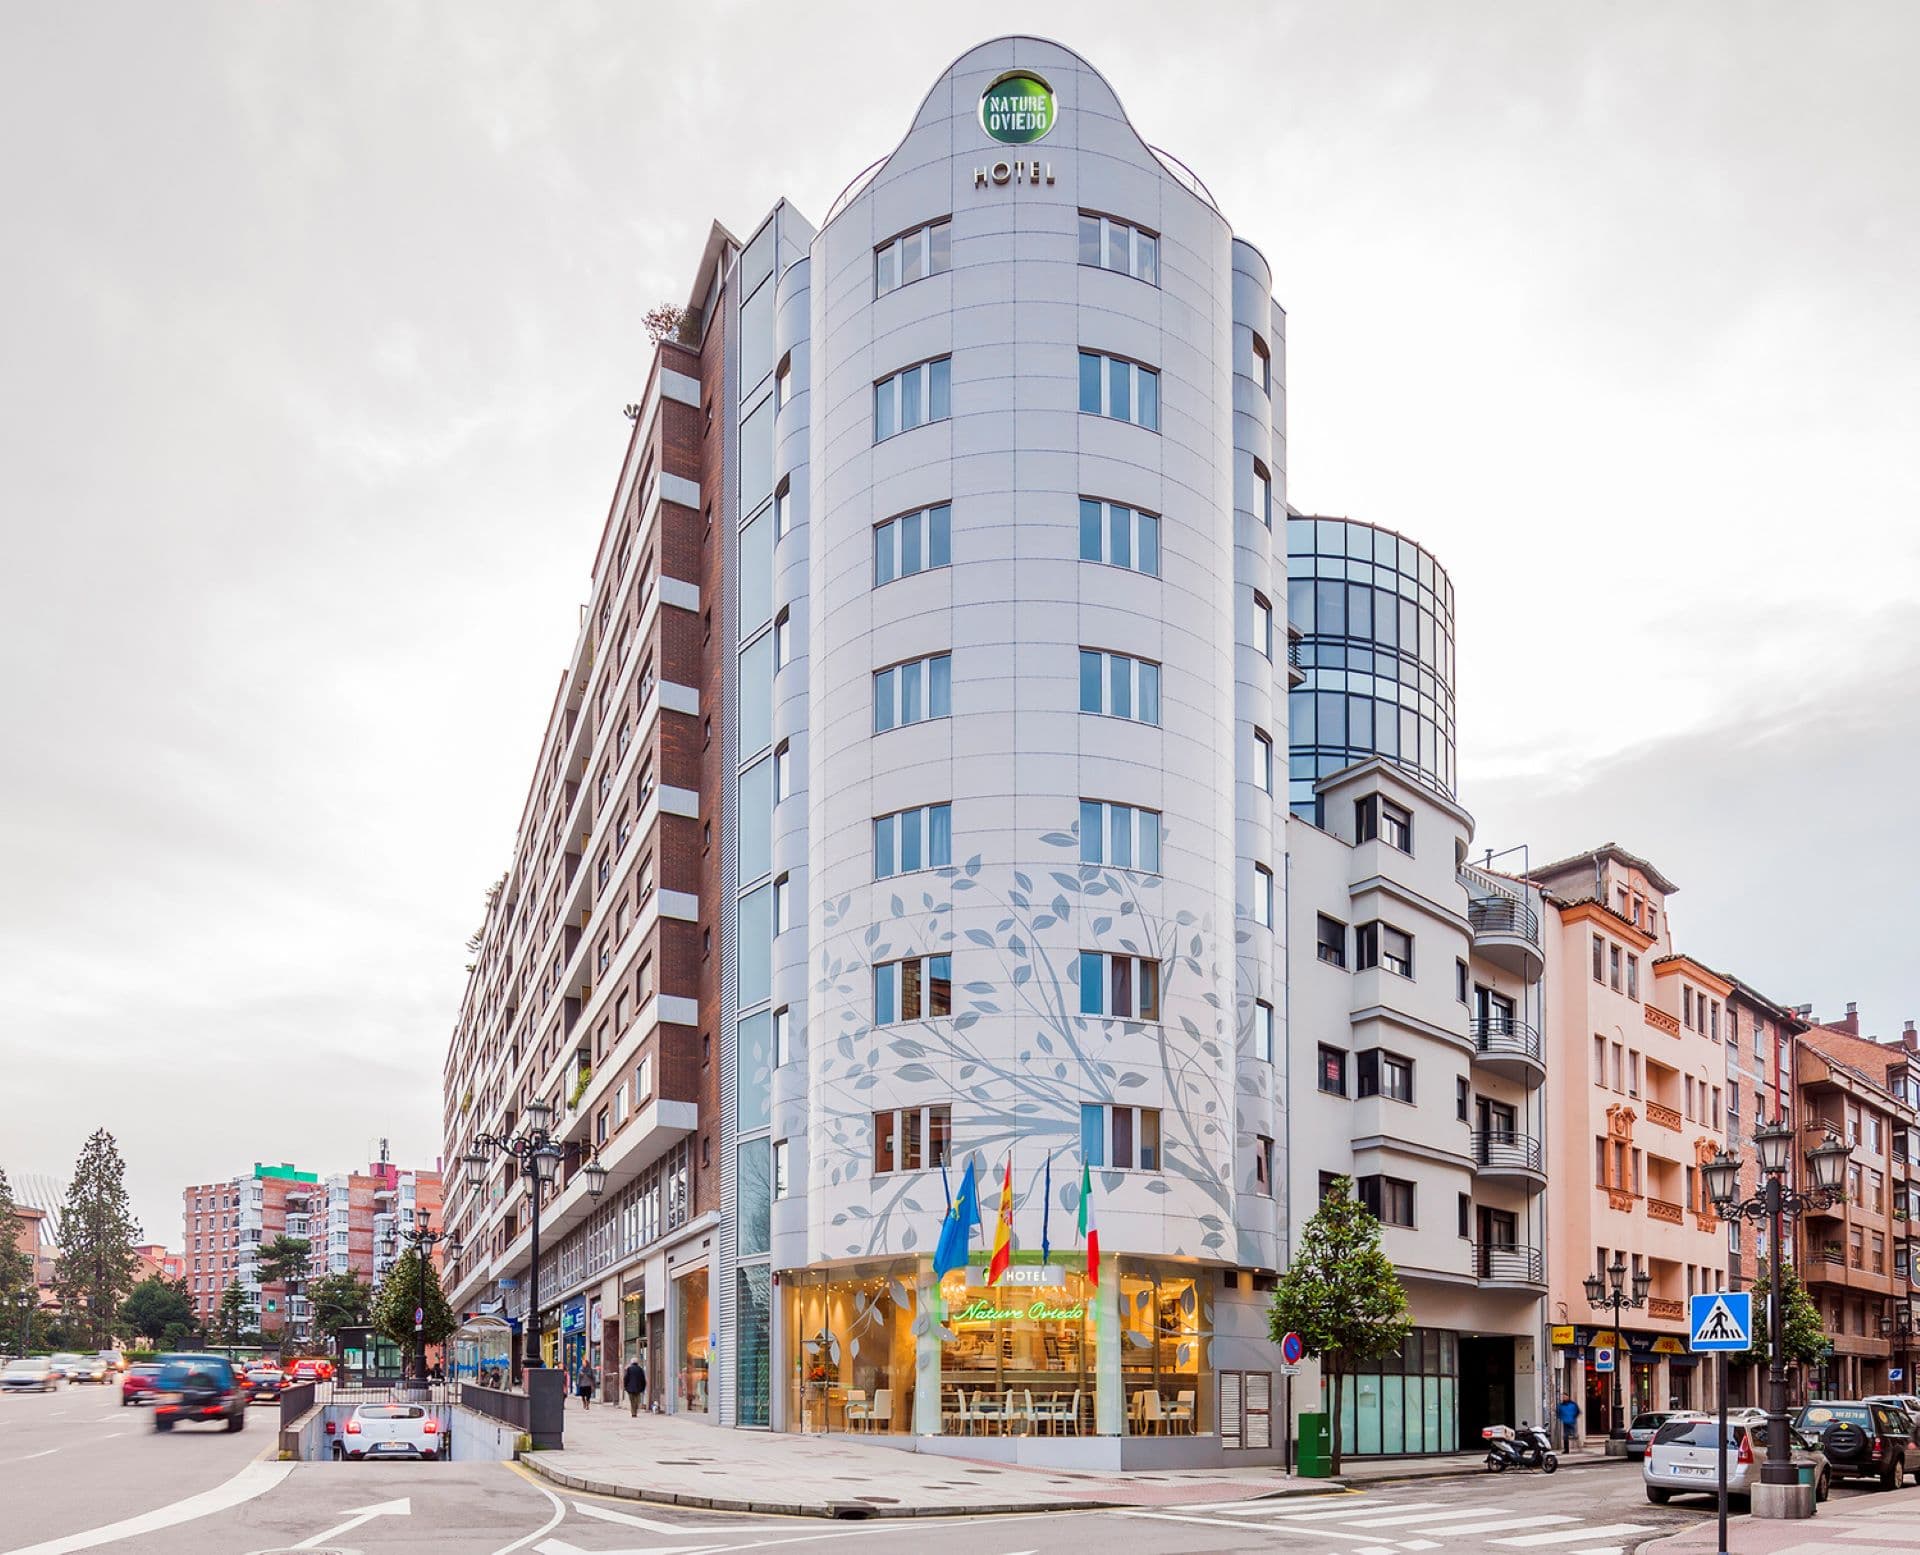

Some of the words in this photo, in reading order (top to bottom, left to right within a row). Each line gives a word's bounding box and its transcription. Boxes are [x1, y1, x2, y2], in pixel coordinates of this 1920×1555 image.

[990, 95, 1046, 112] NATURE
[990, 113, 1046, 131] OVIEDO
[974, 160, 1056, 189] HOTEL
[1006, 1270, 1048, 1282] HOTEL
[953, 1299, 1025, 1320] Nature
[1028, 1301, 1084, 1320] Oviedo
